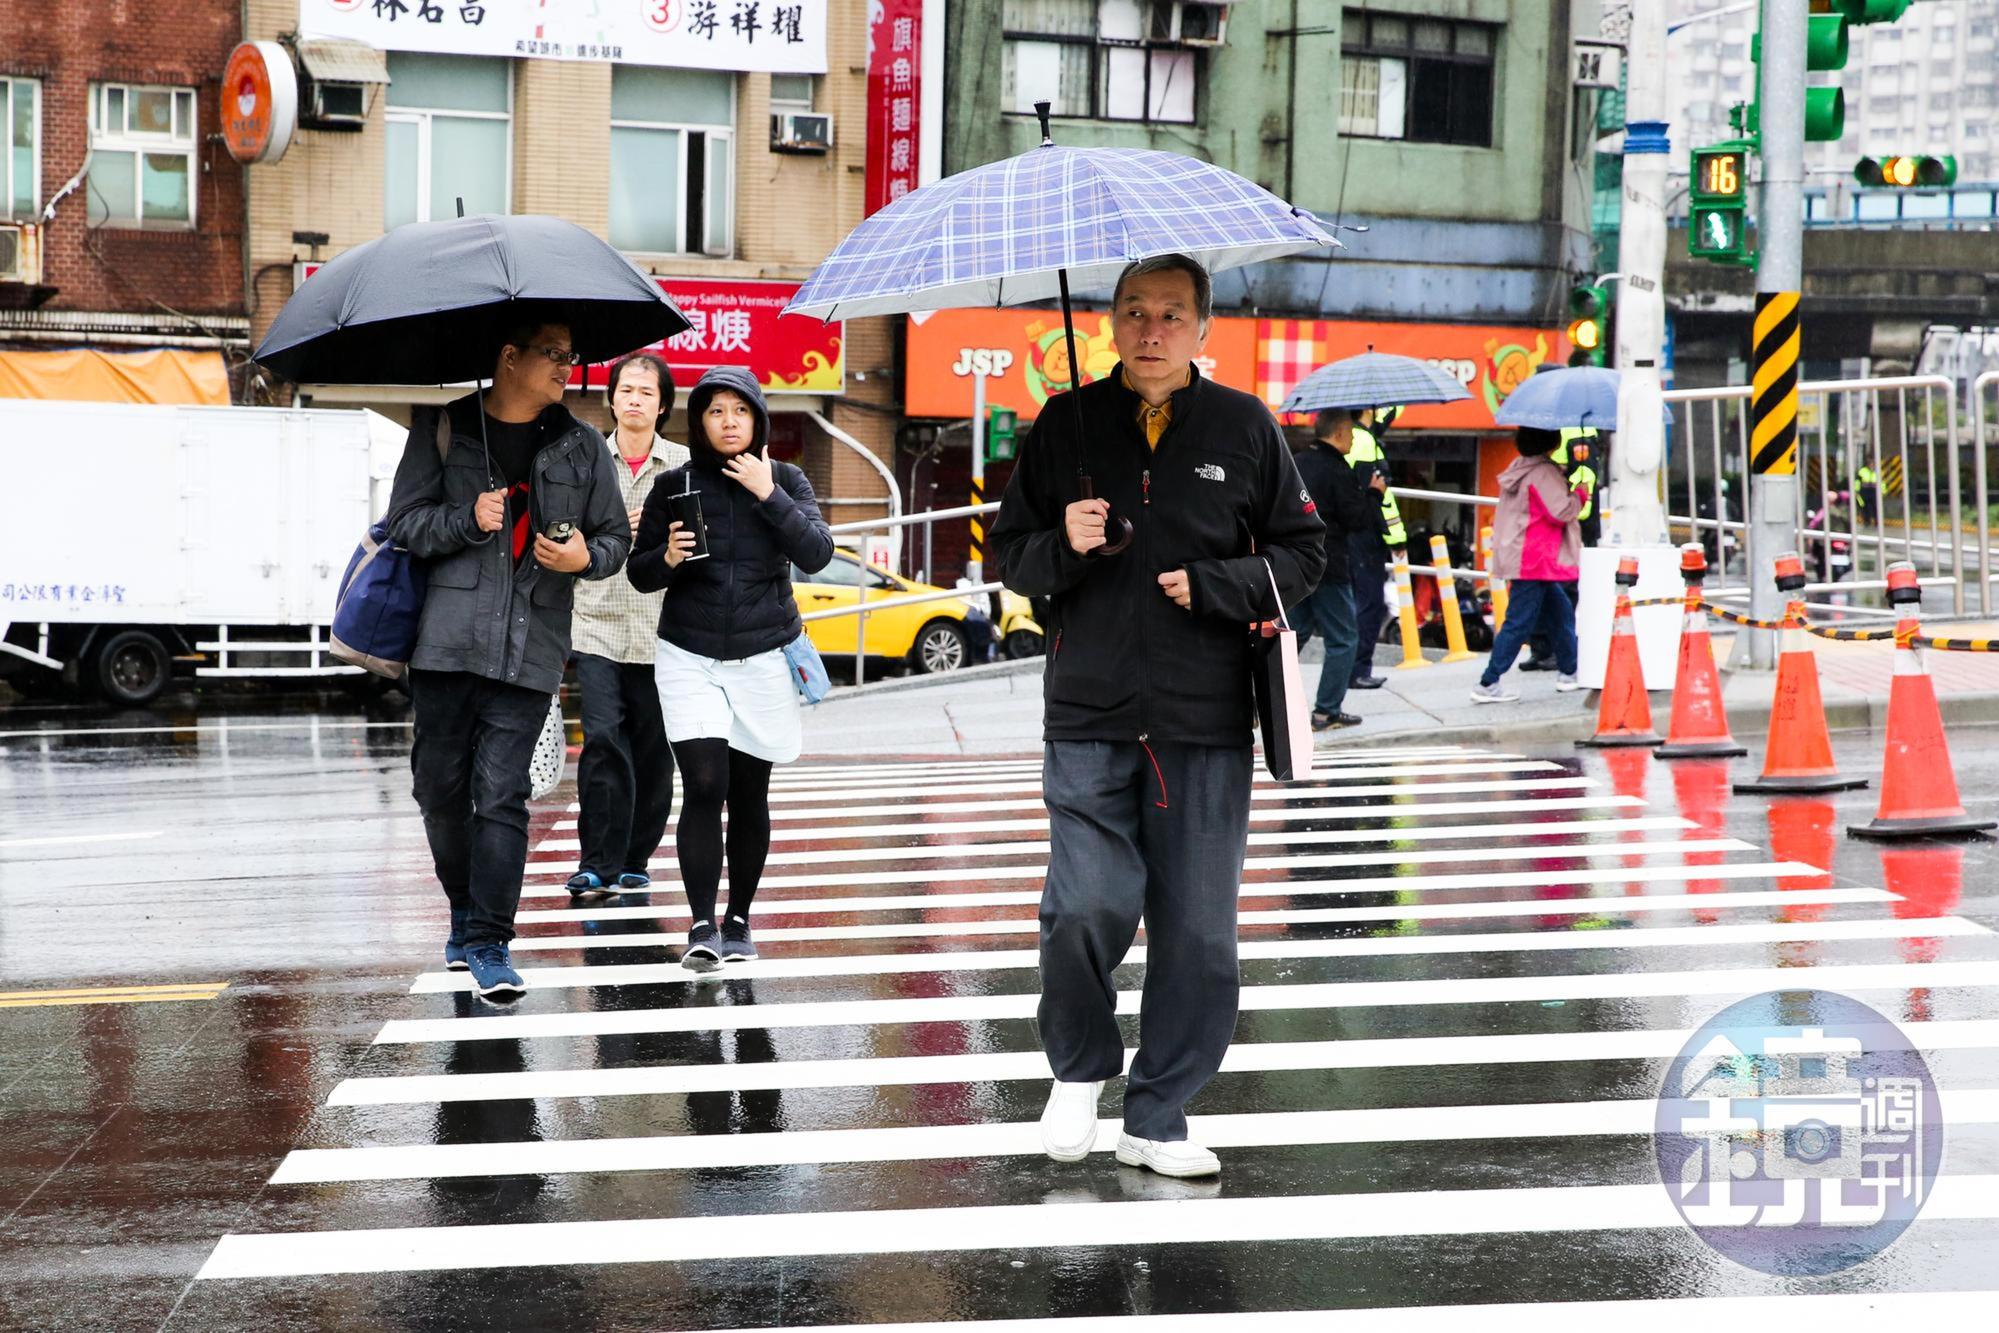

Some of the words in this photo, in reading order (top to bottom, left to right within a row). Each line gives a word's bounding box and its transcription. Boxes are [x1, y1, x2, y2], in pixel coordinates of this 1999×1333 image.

[688, 1, 804, 45] 游祥耀
[1710, 156, 1736, 194] 16
[668, 292, 698, 308] appy
[699, 293, 737, 306] Sailfish
[953, 348, 1013, 377] JSP
[1195, 467, 1216, 476] NORTH
[1200, 472, 1217, 480] FACE
